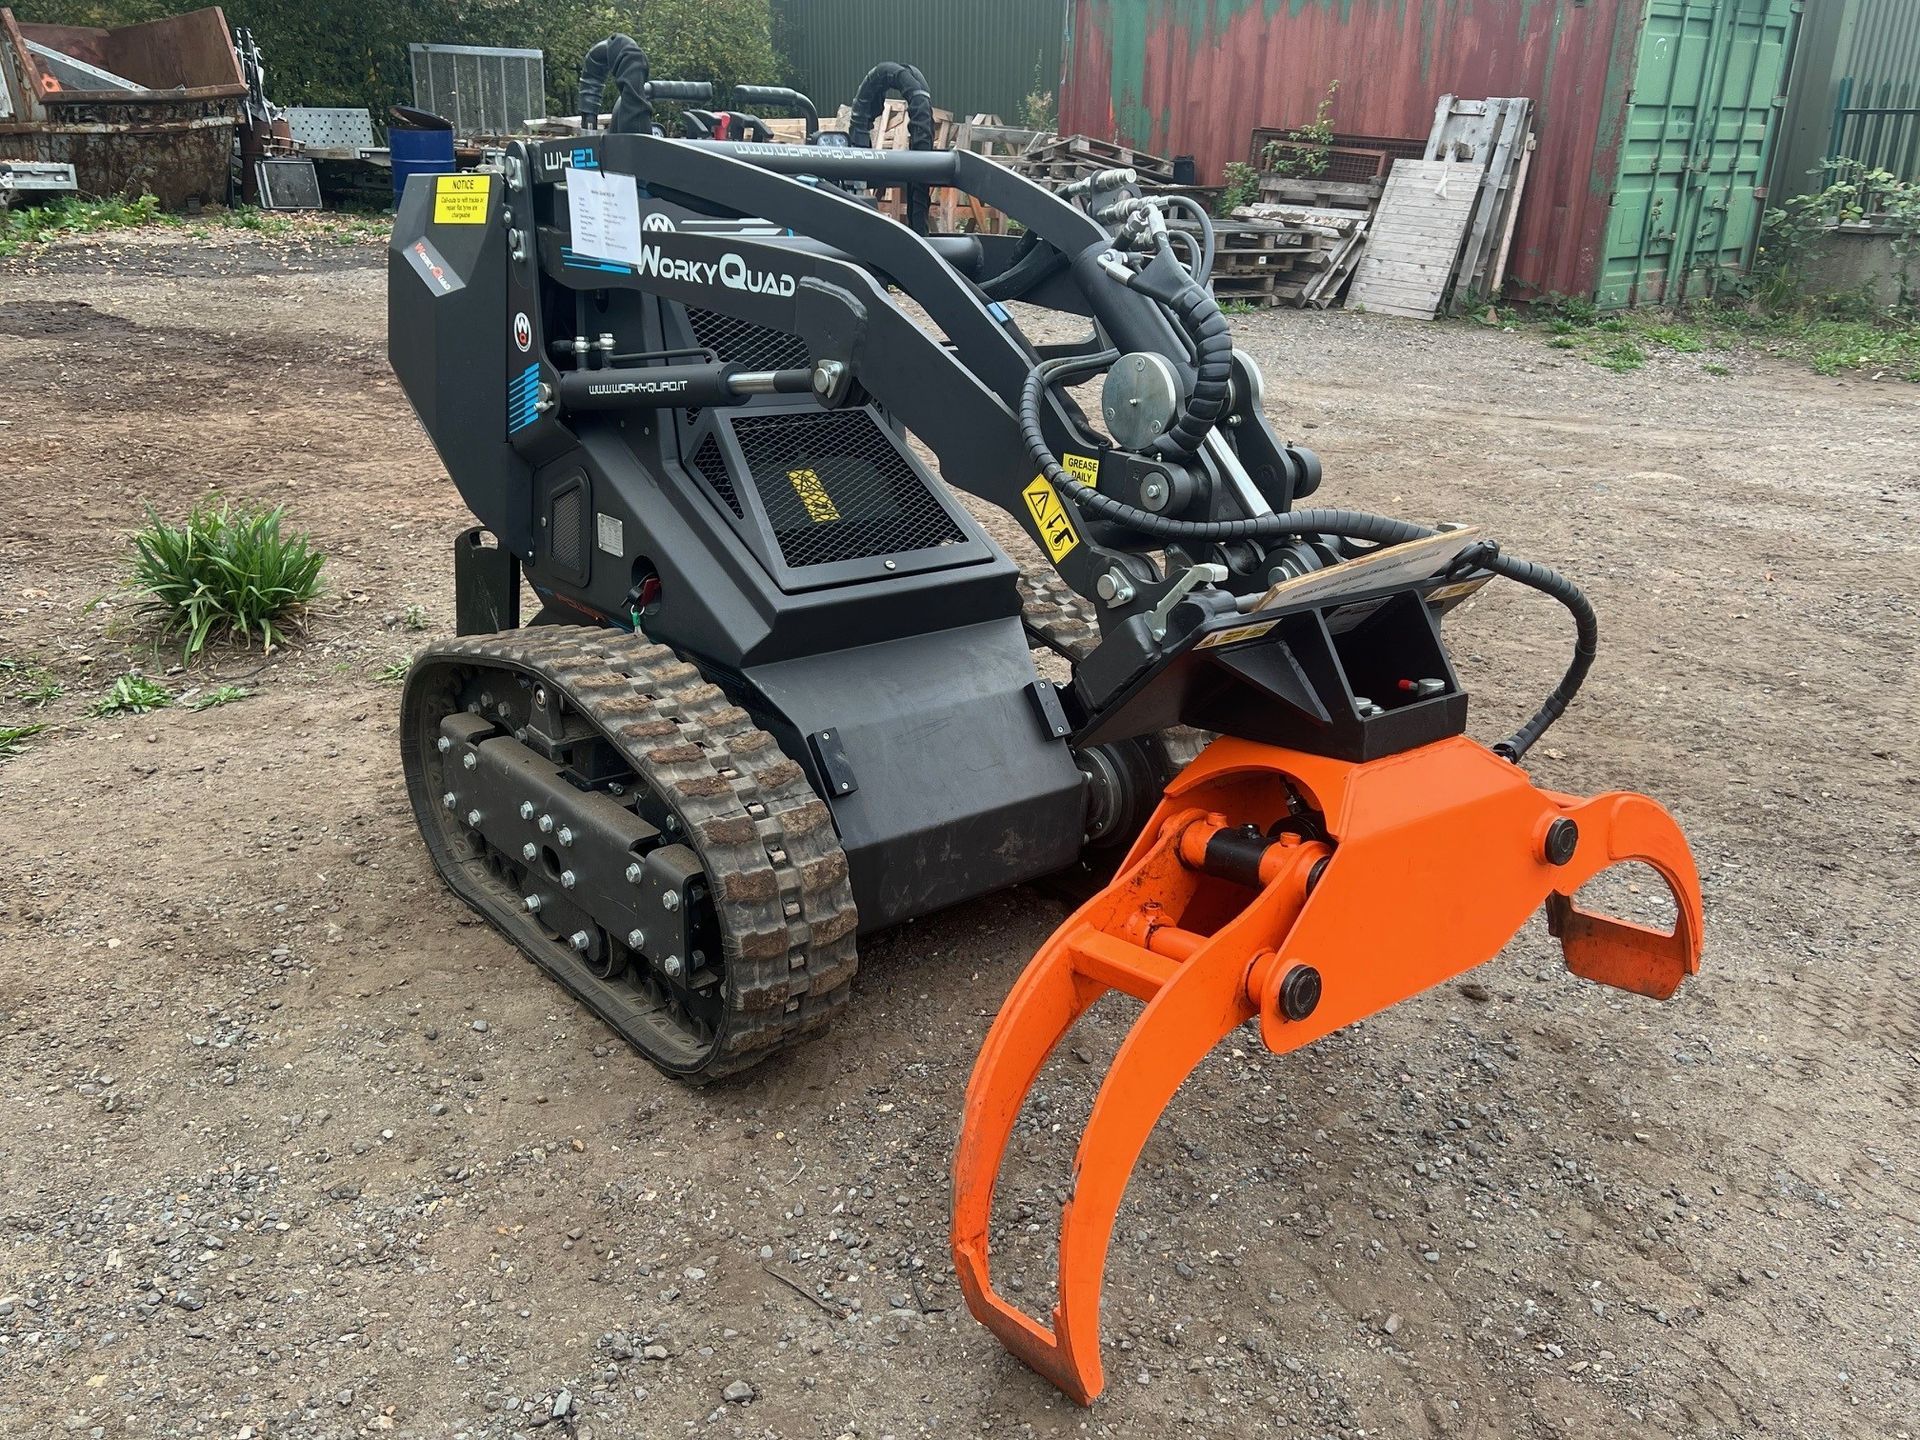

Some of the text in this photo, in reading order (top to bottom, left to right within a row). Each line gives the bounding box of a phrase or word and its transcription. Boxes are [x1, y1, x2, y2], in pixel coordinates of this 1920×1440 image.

[452, 179, 474, 190] NOTICE
[1069, 458, 1097, 472] GREASE
[1071, 470, 1092, 483] DAILY
